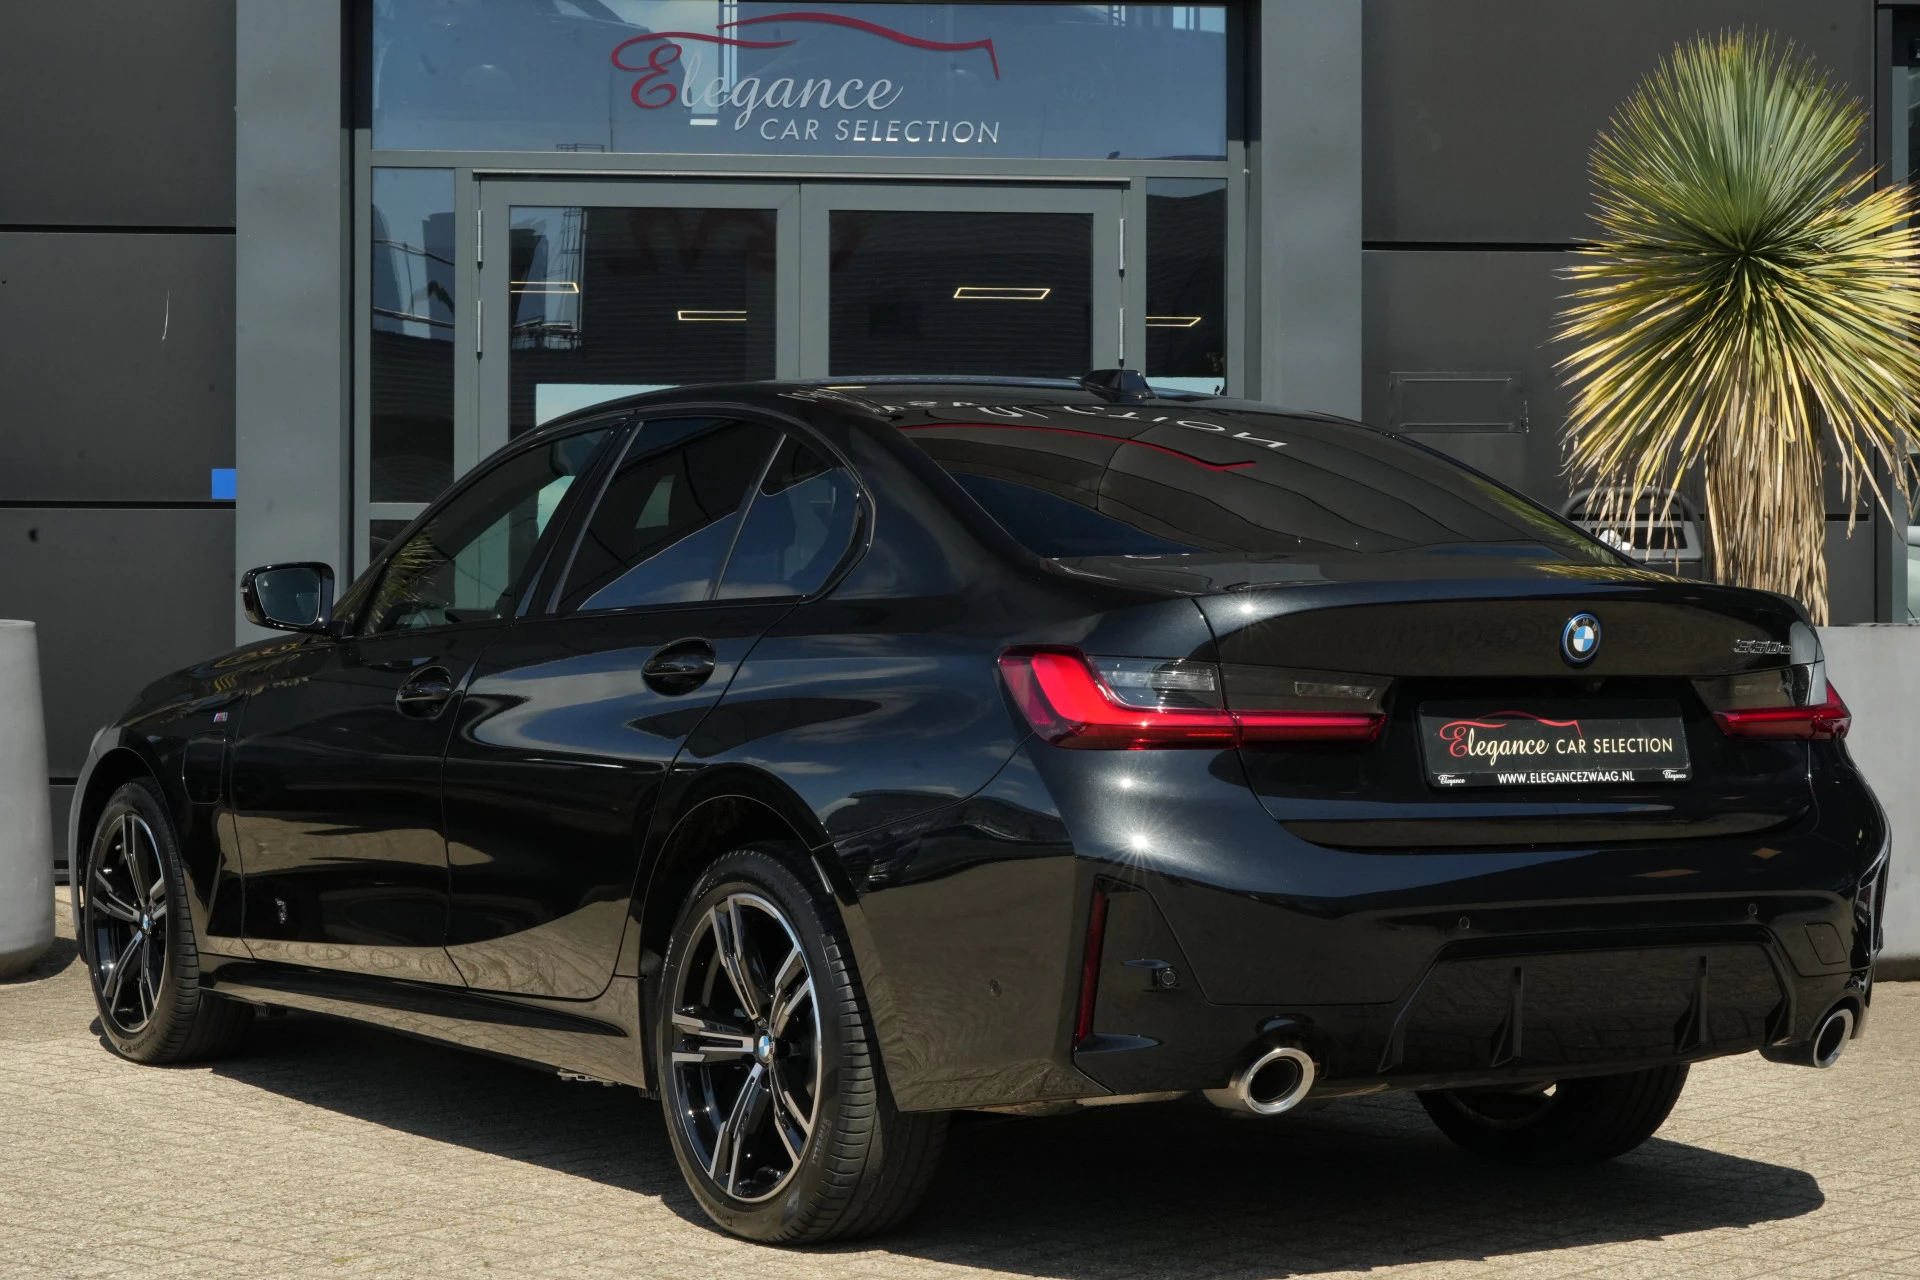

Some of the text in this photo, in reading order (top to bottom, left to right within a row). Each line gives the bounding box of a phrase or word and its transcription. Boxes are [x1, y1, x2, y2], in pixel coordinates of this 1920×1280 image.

[611, 31, 904, 131] Elegance
[760, 118, 1000, 143] CAR SELECTION
[1439, 720, 1673, 767] Elegance CAR SELECTION
[1438, 774, 1466, 786] Elegance
[1497, 770, 1636, 784] WWW.ELEGANCEZWAAG.NL
[1662, 769, 1687, 781] Elegance
